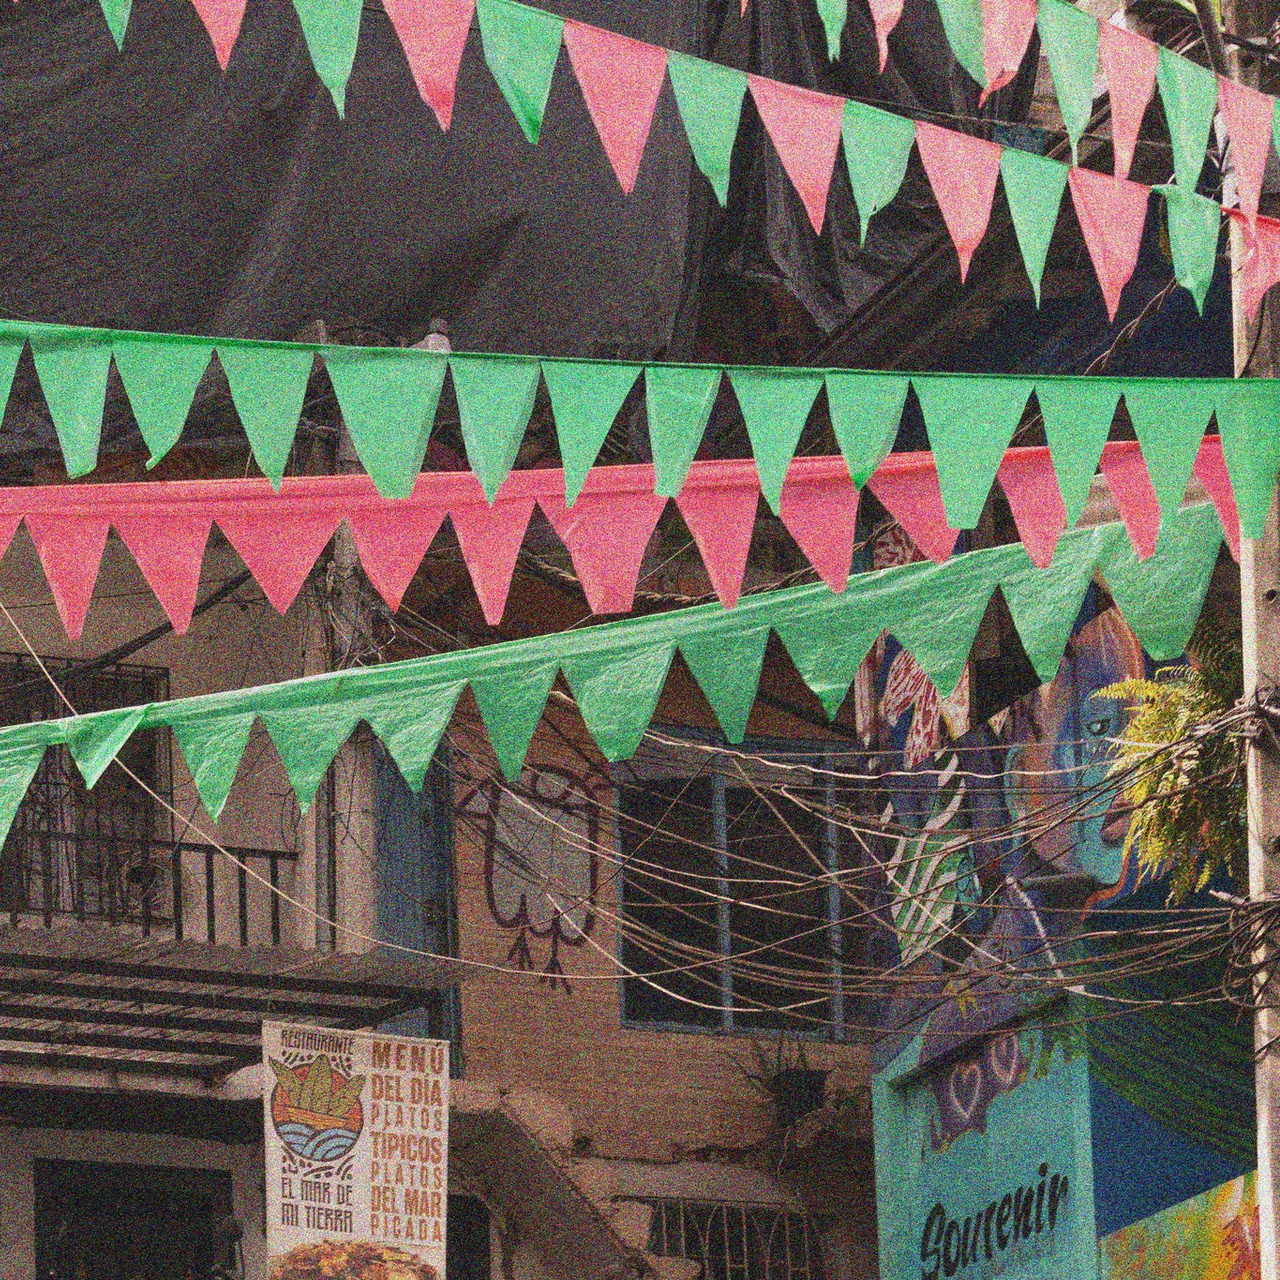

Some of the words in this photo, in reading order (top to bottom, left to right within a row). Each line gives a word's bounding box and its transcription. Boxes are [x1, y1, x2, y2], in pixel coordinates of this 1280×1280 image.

[371, 1073, 403, 1102] DEL
[370, 1103, 443, 1132] PLATOS
[370, 1160, 443, 1190] PLATOS
[281, 1177, 295, 1200] EL
[301, 1179, 332, 1204] MAR
[336, 1183, 353, 1207] DE
[370, 1185, 399, 1214] DEL
[404, 1188, 442, 1218] MAR
[281, 1203, 299, 1227] MI
[305, 1205, 354, 1234] TIERRA
[370, 1213, 442, 1242] PICADA
